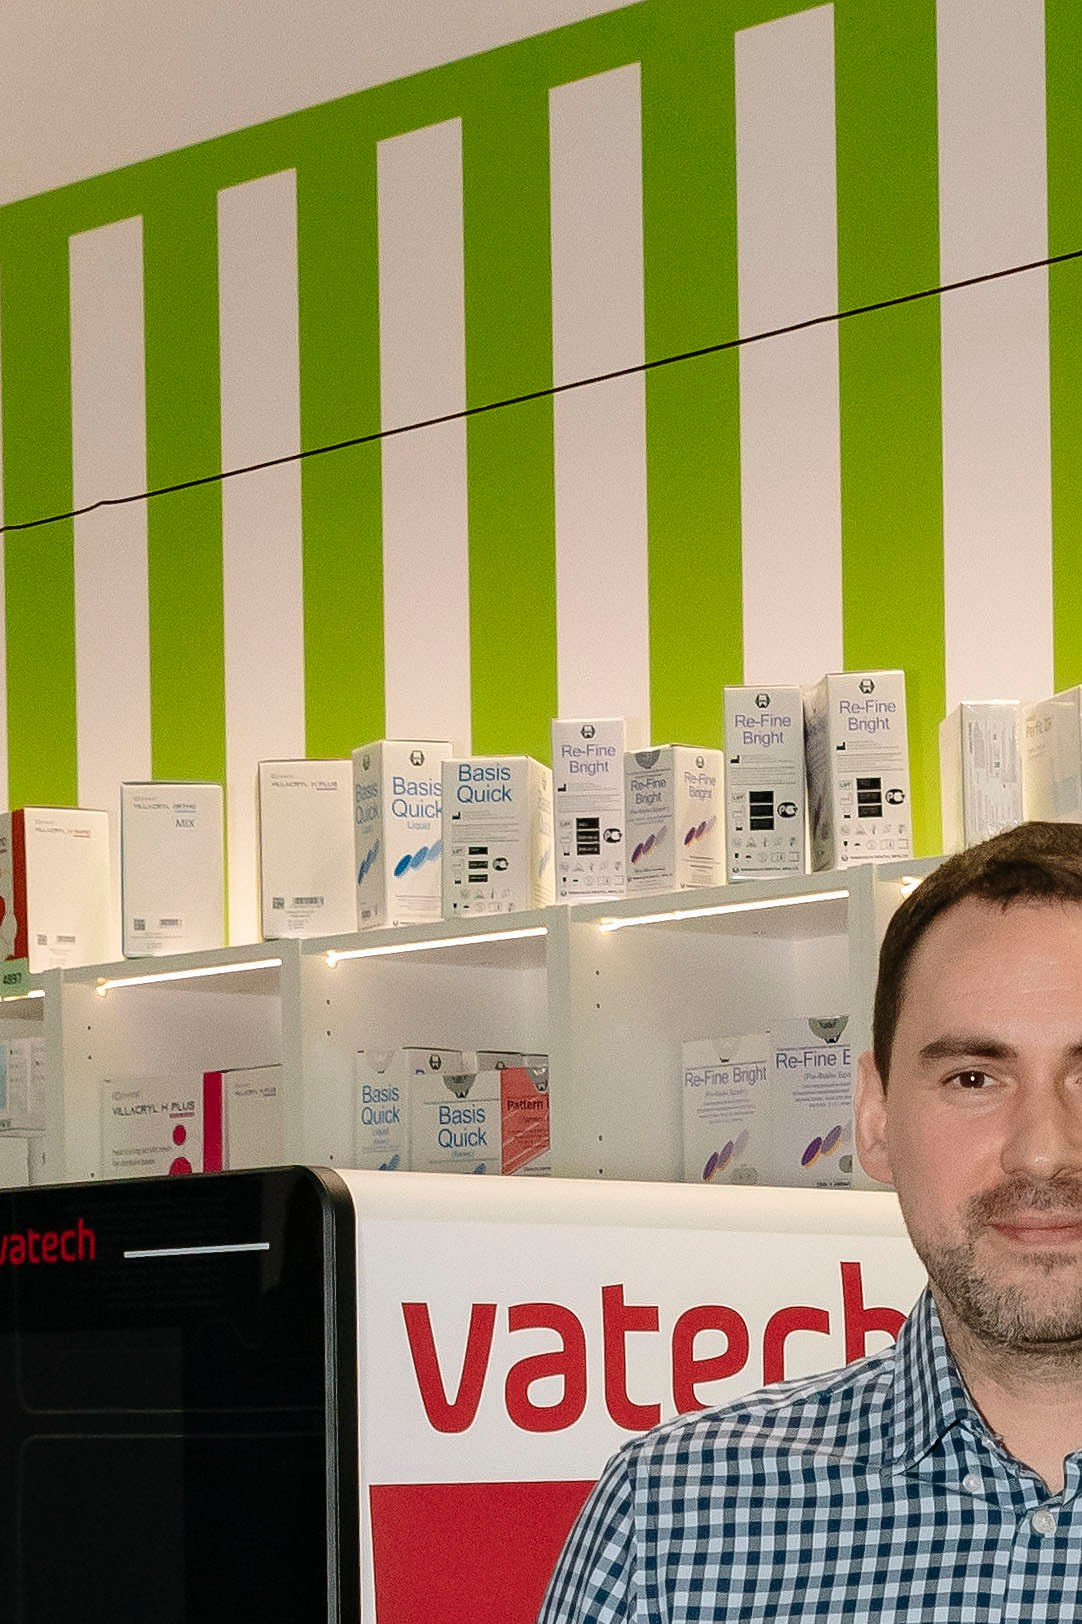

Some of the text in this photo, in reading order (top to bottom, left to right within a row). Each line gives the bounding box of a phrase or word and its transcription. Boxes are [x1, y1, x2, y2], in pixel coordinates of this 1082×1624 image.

[840, 700, 896, 714] Re-Fine
[734, 715, 792, 728] Re-Fine
[848, 717, 890, 733] Bright
[743, 731, 784, 747] Bright
[561, 745, 616, 758] Re-Fine
[458, 764, 511, 782] Basis
[569, 760, 609, 776] Bright
[392, 777, 442, 797] Basis
[457, 784, 512, 803] Quick
[631, 778, 667, 791] Re-Fine
[391, 799, 443, 818] Quick
[776, 1051, 836, 1069] Re-Fine
[685, 1066, 767, 1087] Re-Fine Bright
[362, 1085, 399, 1103] Basis
[170, 1101, 195, 1111] PLUS
[439, 1104, 486, 1124] Basis
[507, 1100, 544, 1111] Pattern
[361, 1106, 400, 1125] Quick
[438, 1128, 488, 1148] Quick
